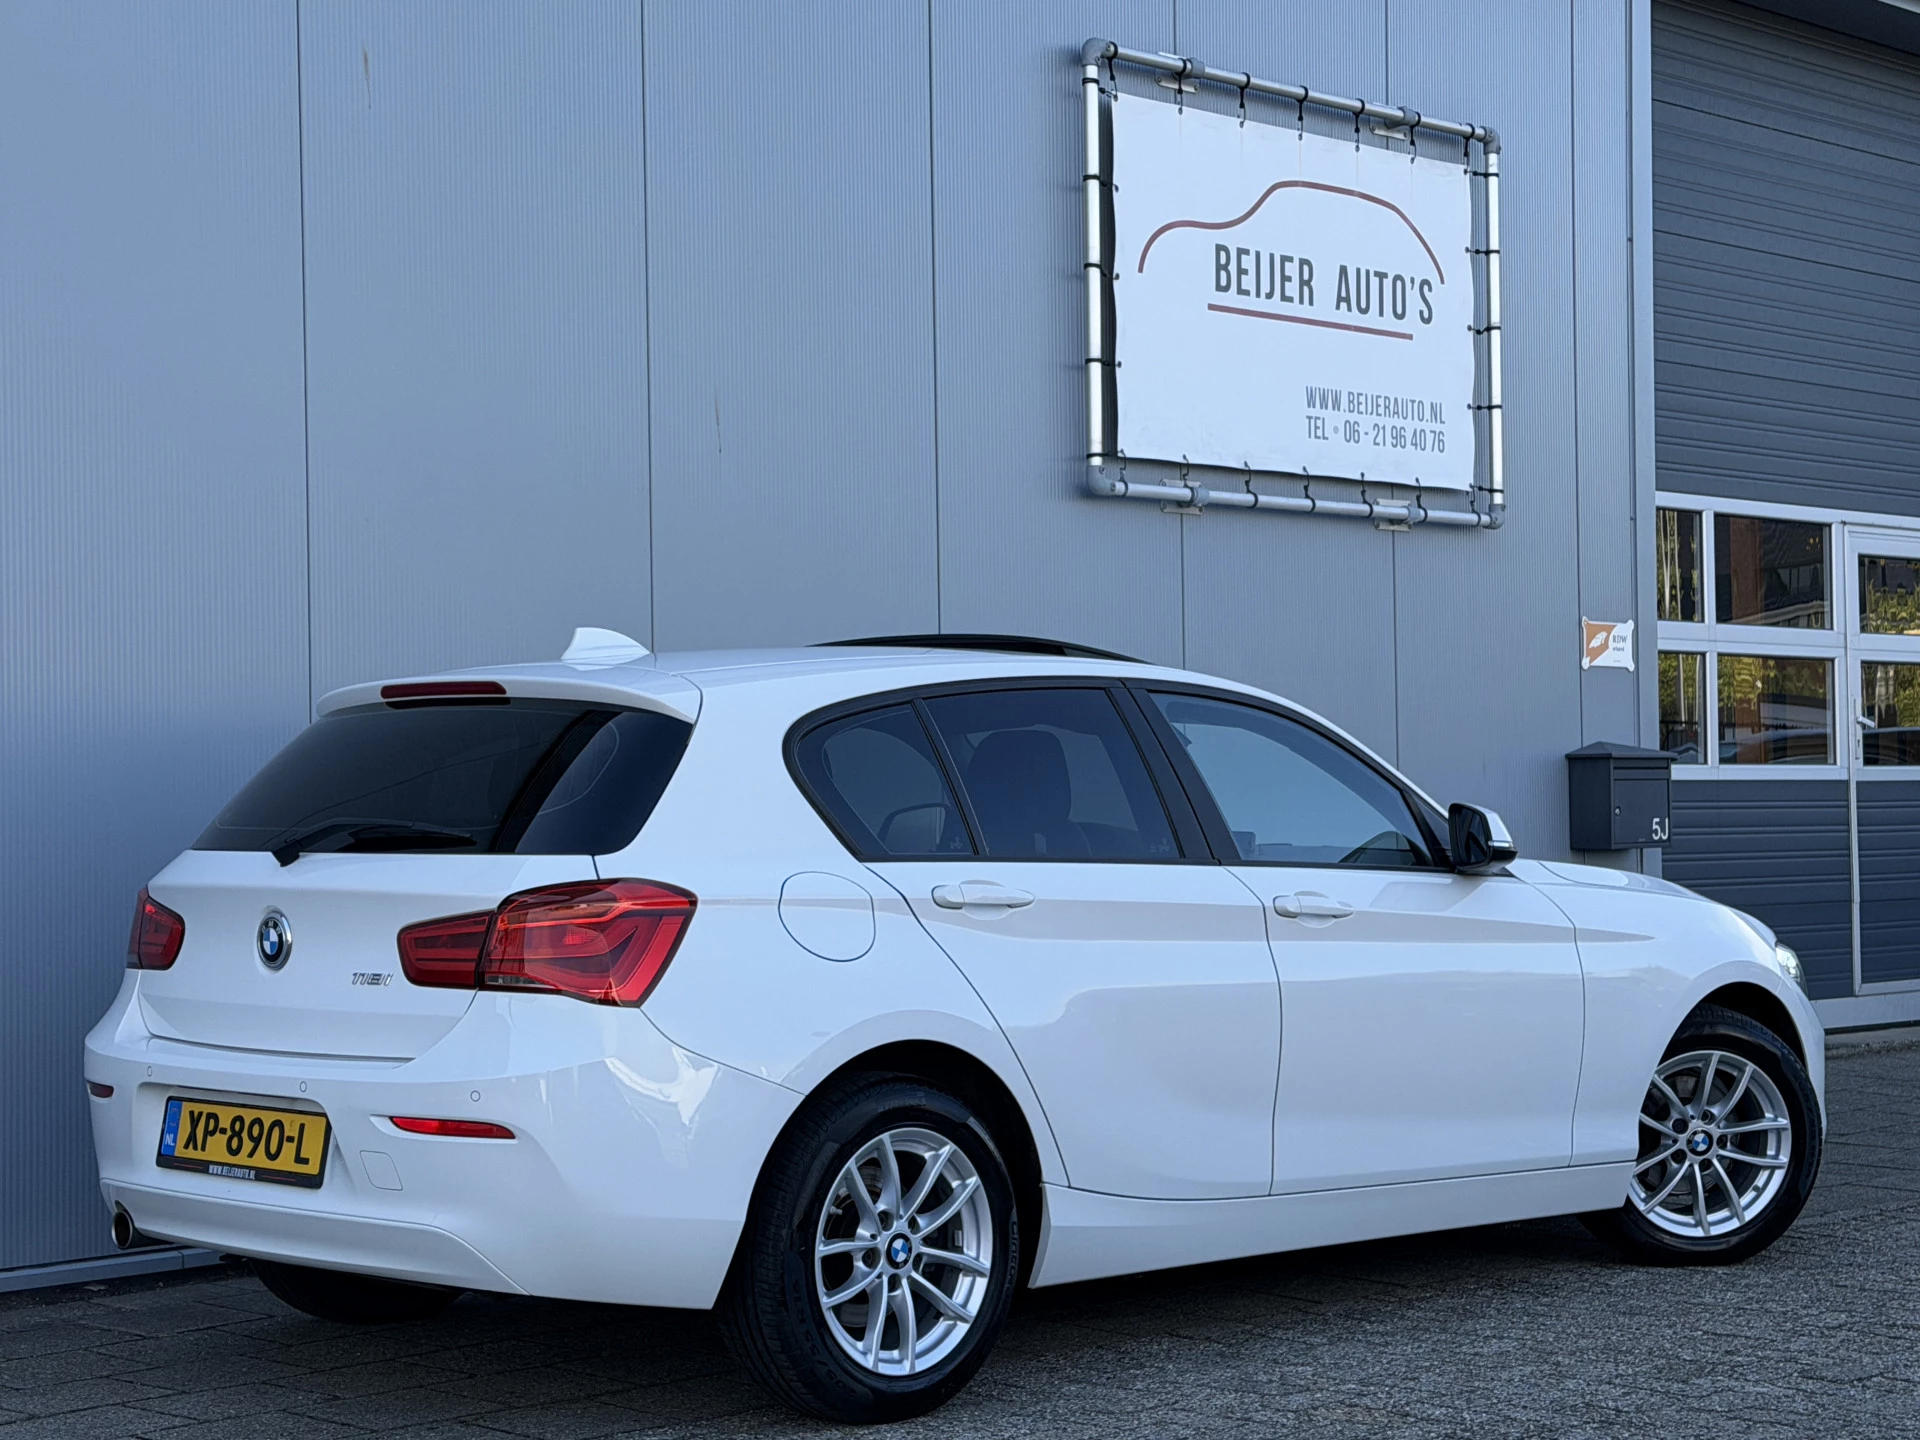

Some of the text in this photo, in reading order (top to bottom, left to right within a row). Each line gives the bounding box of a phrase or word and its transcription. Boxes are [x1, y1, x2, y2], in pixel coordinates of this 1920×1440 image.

[1214, 243, 1434, 325] BEIJER AUTO'S
[1305, 386, 1446, 425] WWW.BEIJERAUTO.NL
[1305, 415, 1329, 441] TEL
[1612, 634, 1628, 644] RDW
[1652, 817, 1669, 840] 5J
[165, 1132, 176, 1146] NL
[182, 1109, 310, 1165] XP-890-L
